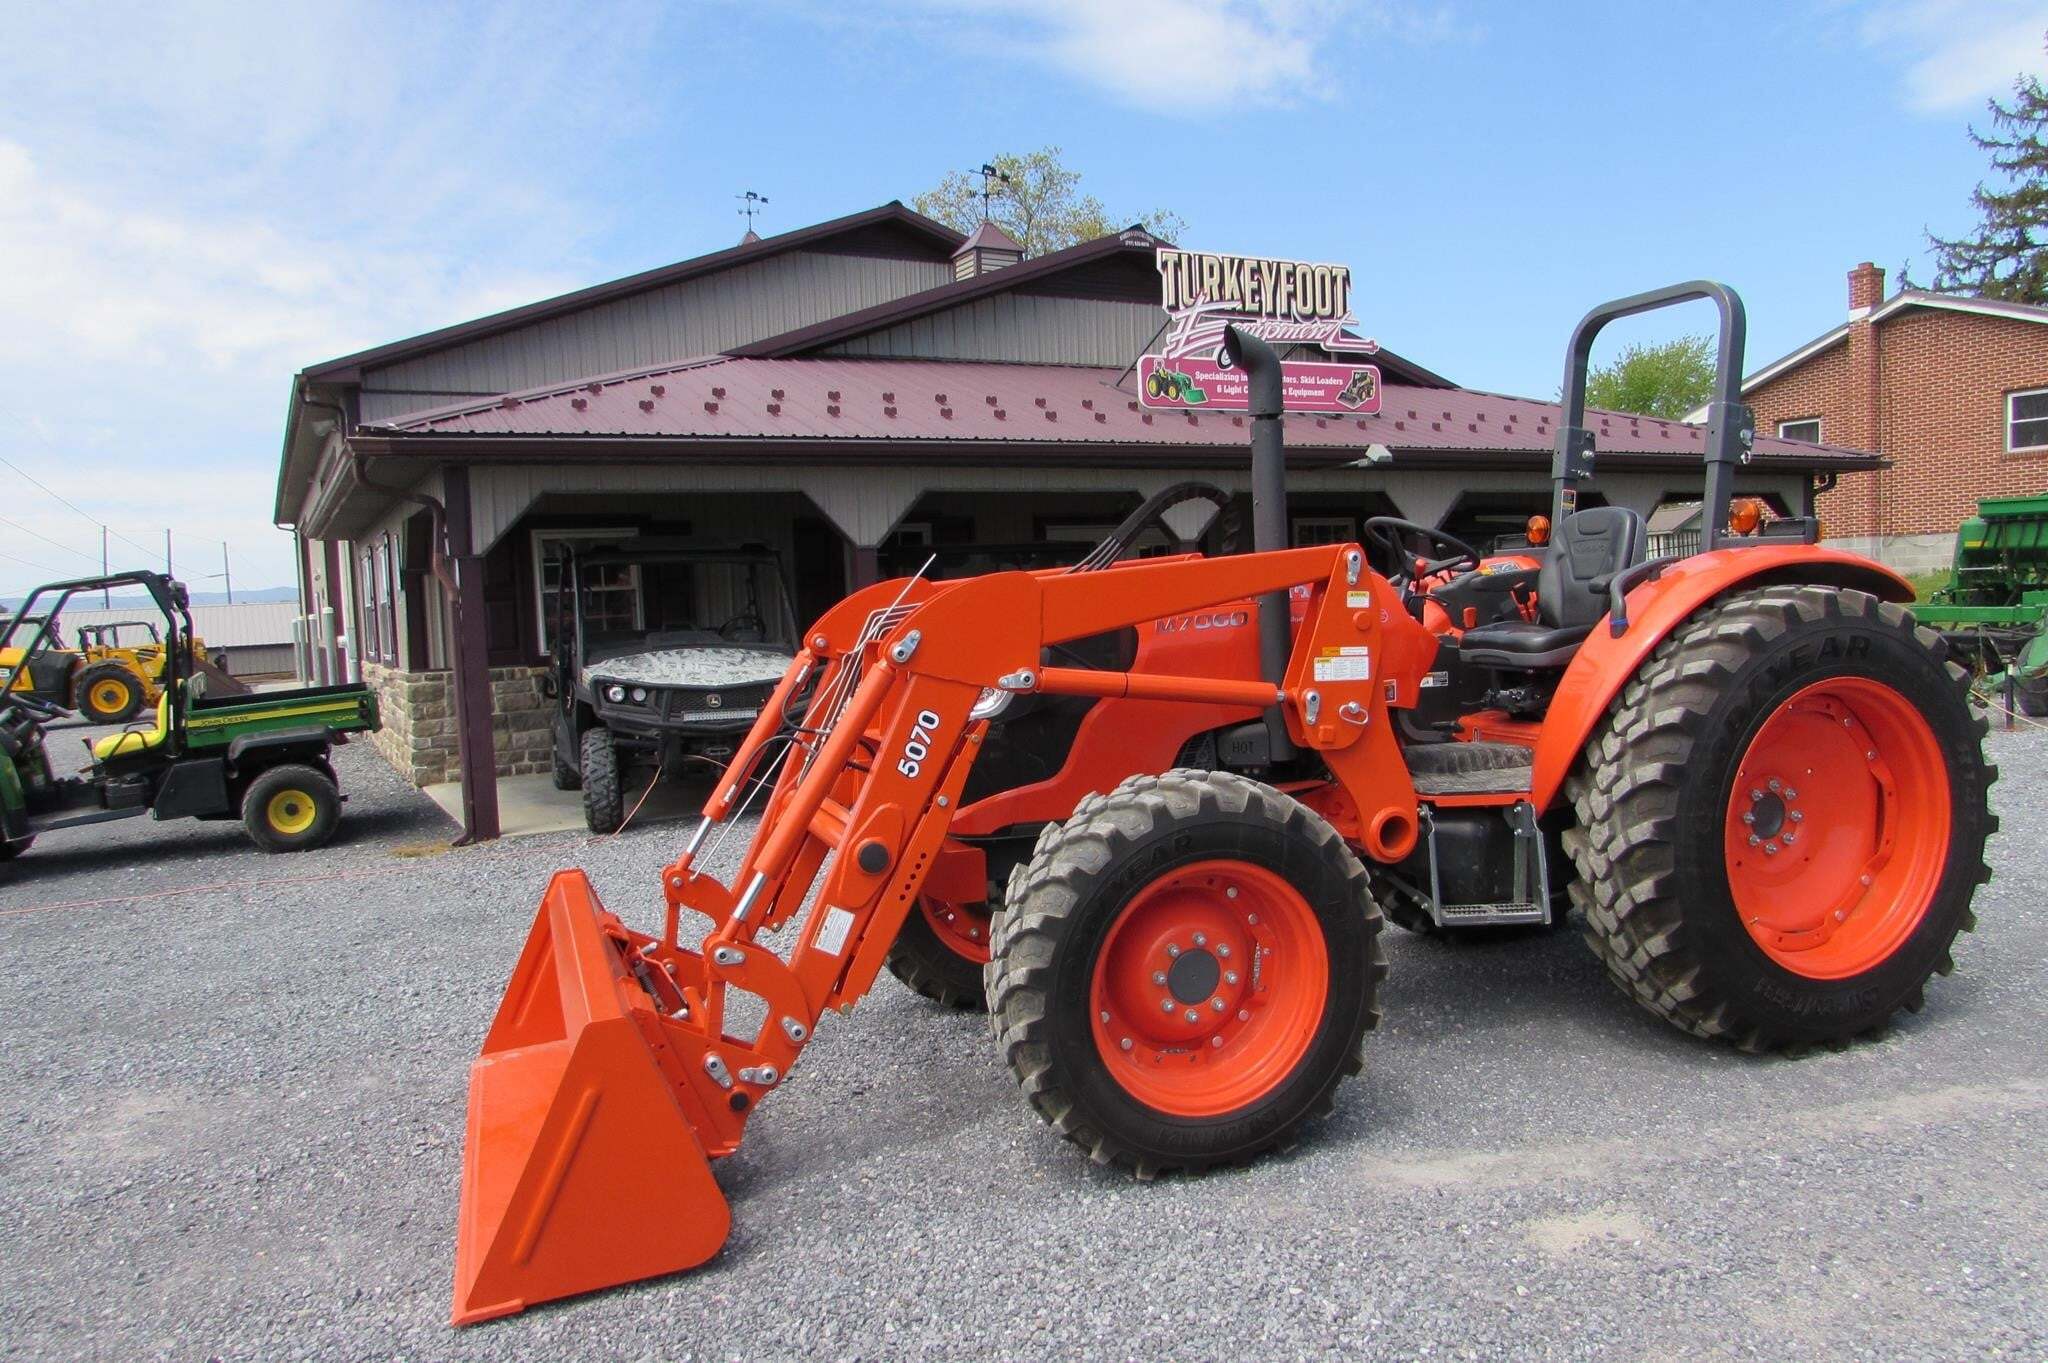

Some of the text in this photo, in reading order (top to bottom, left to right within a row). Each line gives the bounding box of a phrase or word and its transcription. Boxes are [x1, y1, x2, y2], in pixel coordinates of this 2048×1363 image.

[1161, 251, 1349, 317] TURKEYFOOT
[1166, 290, 1378, 358] Euipment
[1194, 371, 1240, 383] Specializing
[1299, 375, 1315, 385] Skid
[1316, 376, 1344, 386] Loaders
[1223, 384, 1242, 395] Light
[1288, 387, 1325, 398] Equipment
[897, 709, 940, 779] 5070
[1232, 741, 1255, 753] HOT
